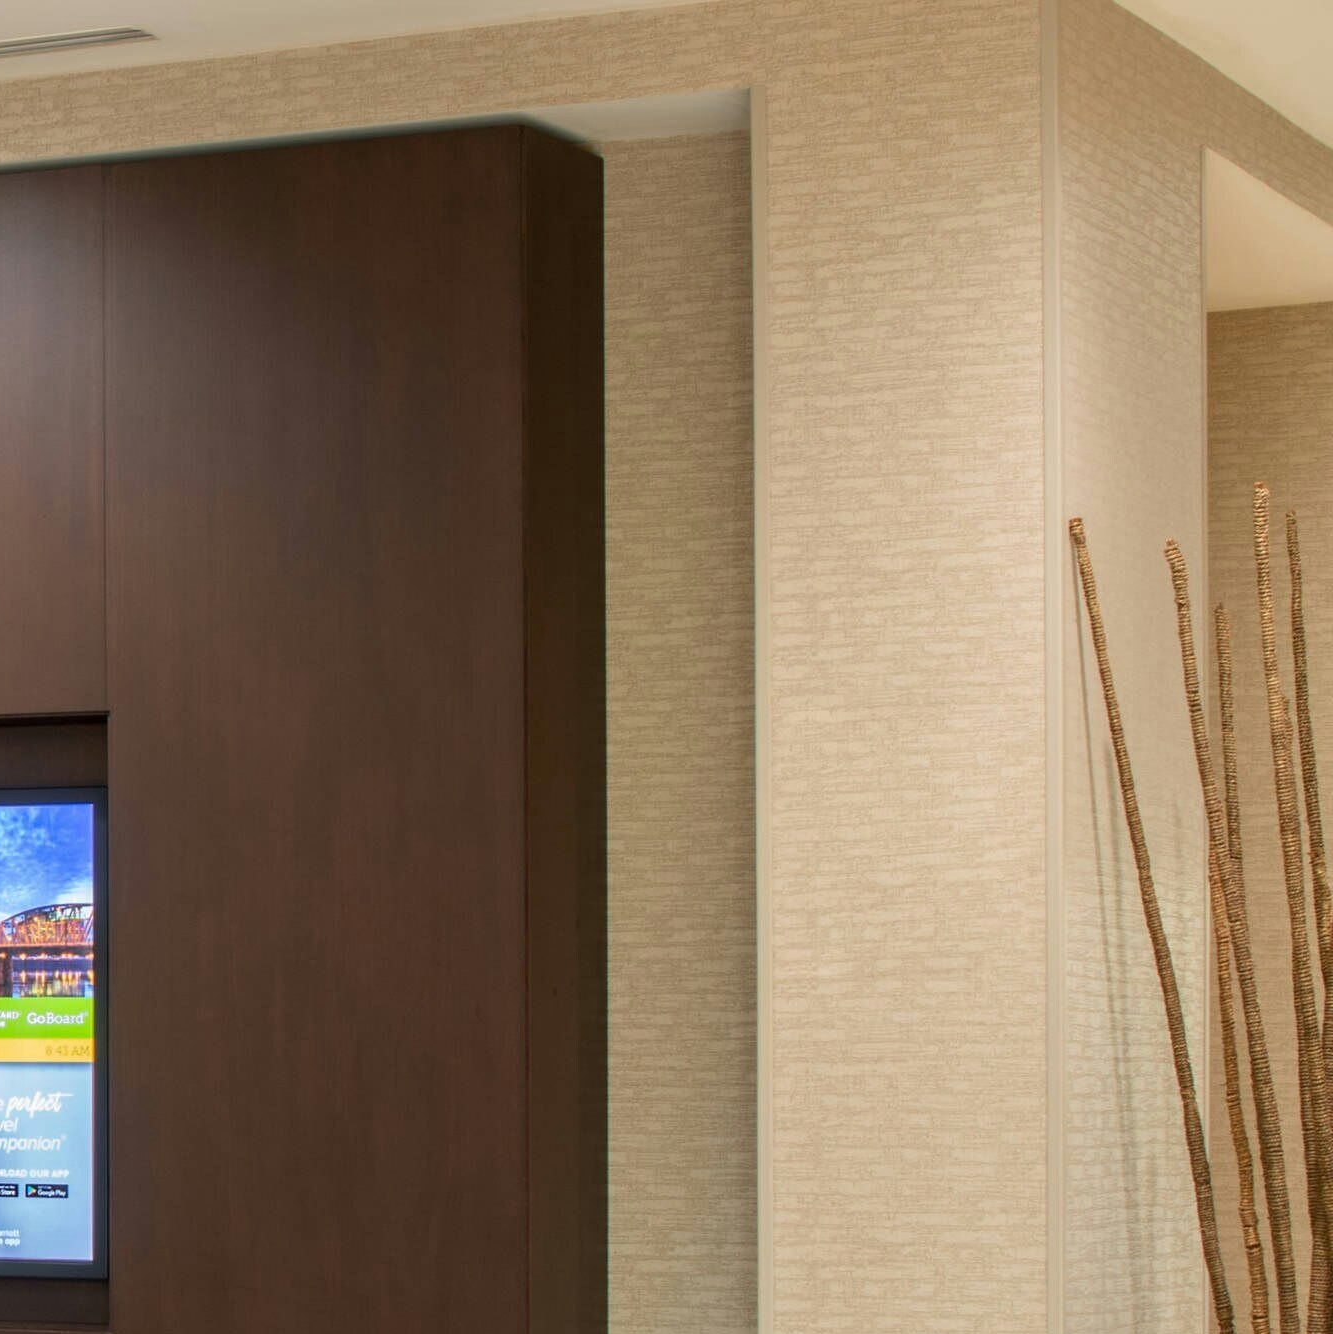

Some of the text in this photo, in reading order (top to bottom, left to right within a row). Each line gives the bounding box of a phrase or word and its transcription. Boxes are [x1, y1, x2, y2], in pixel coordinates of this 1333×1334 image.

[5, 1090, 74, 1119] perfect
[29, 1169, 50, 1178] OUR
[51, 1169, 69, 1178] APP
